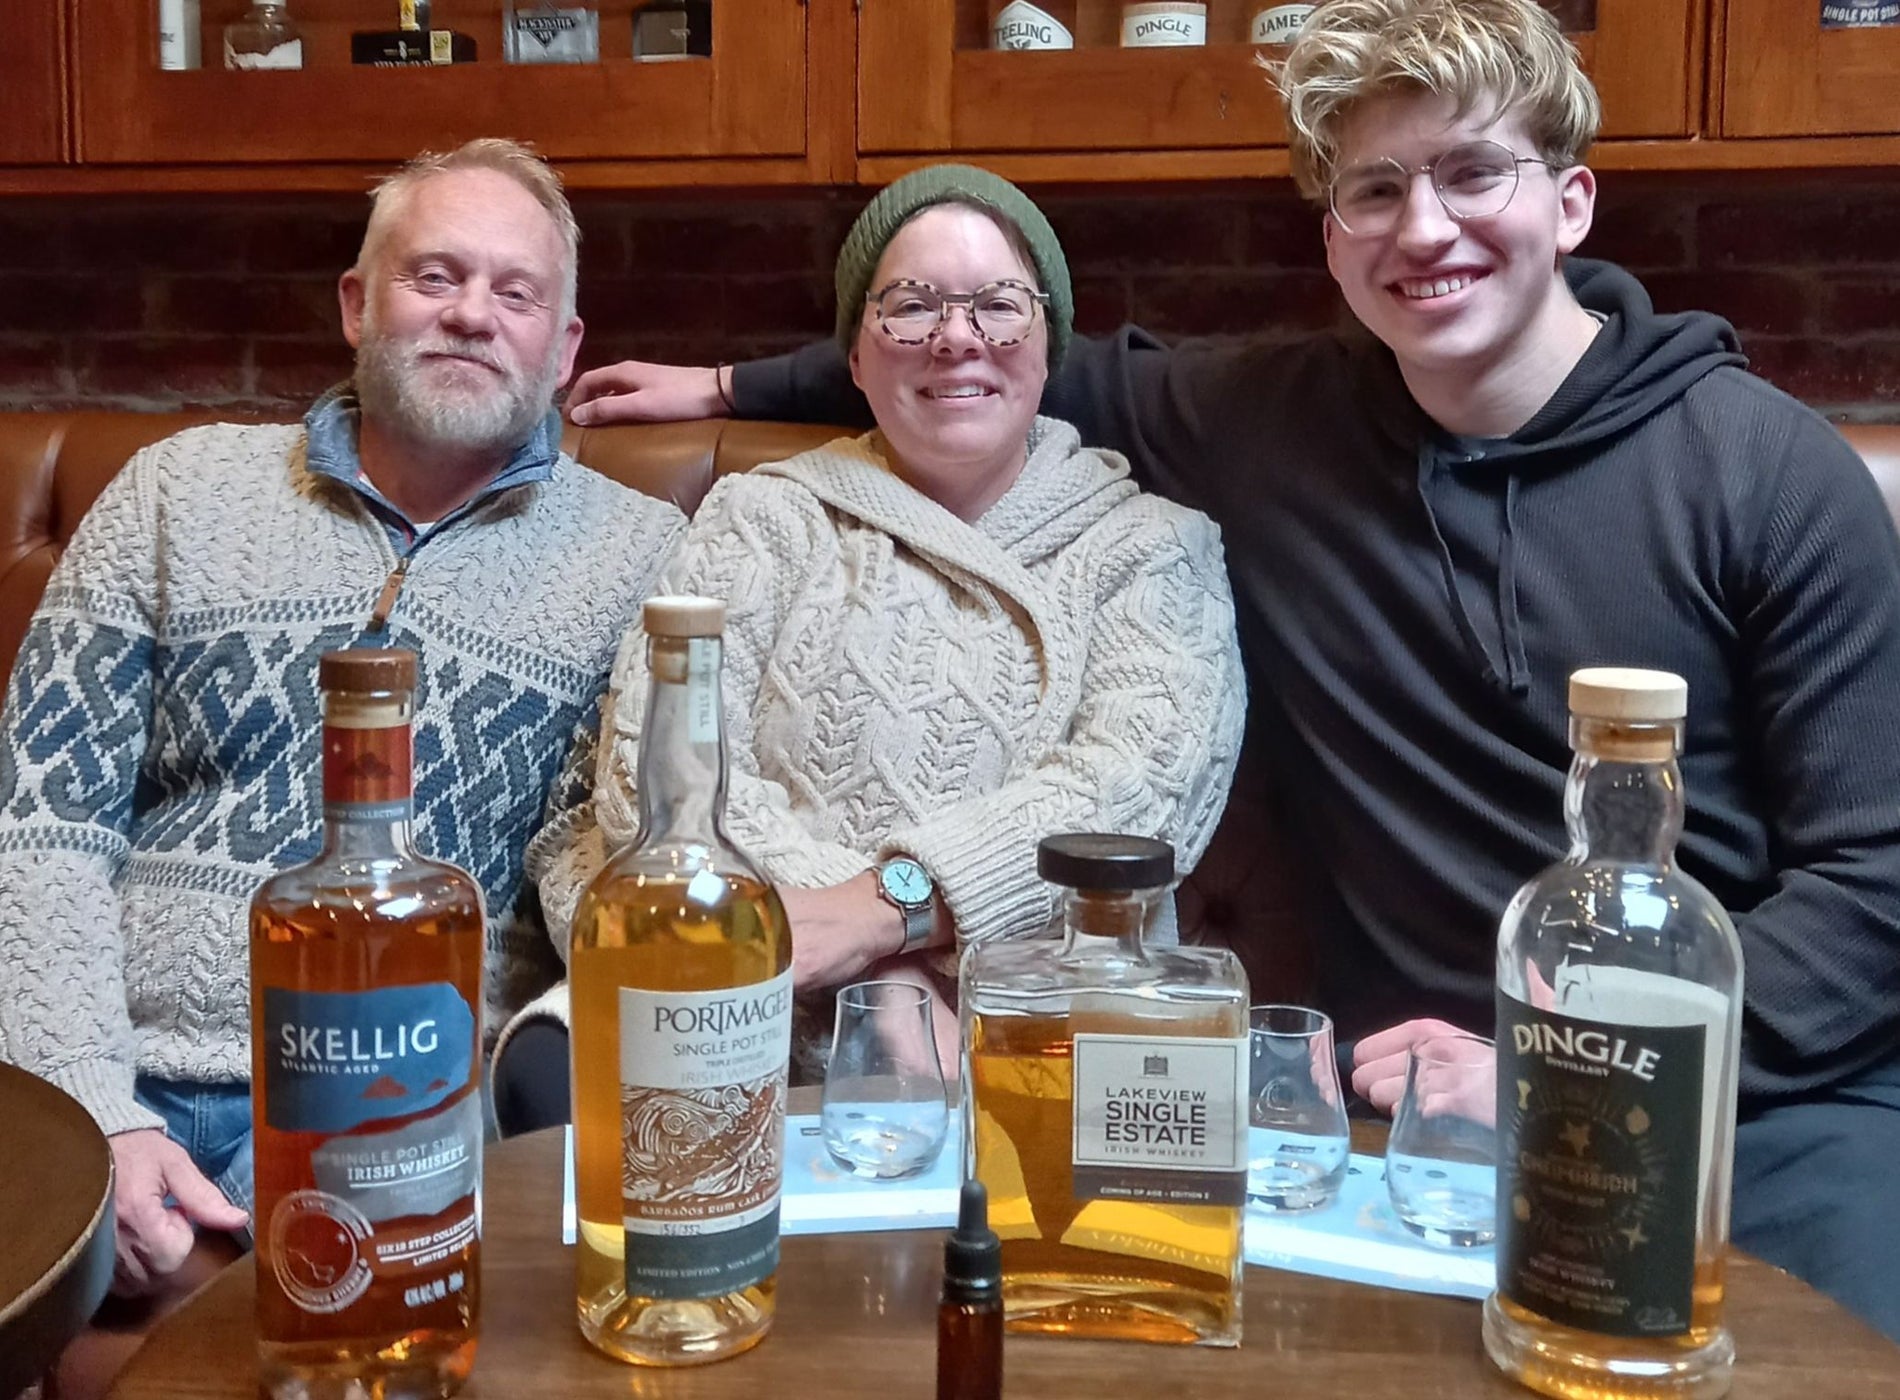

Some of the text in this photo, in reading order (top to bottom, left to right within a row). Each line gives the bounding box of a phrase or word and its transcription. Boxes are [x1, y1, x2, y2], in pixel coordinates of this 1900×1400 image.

[1823, 4, 1859, 21] SINGLE
[1860, 7, 1880, 21] POT
[995, 22, 1052, 45] TEELING
[1135, 19, 1192, 38] DINGLE
[280, 1019, 438, 1061] SKELLIG
[673, 1040, 727, 1057] SINGLE
[732, 1033, 758, 1051] POT
[1512, 1023, 1662, 1083] DINGLE
[281, 1058, 380, 1075] ATLANTIC AGED
[1105, 1086, 1207, 1102] LAKEVIEW
[1105, 1100, 1207, 1125] SINGLE
[1105, 1122, 1206, 1146] ESTATE
[329, 1149, 389, 1167] SINGLE
[396, 1144, 427, 1160] POT
[1104, 1145, 1206, 1158] IRISH WHISKEY
[347, 1144, 466, 1181] IRISH WHISKEY
[1170, 1190, 1203, 1199] EDITION
[640, 1204, 704, 1217] BARBADOS
[707, 1201, 736, 1214] RUM
[408, 1235, 432, 1250] STEP
[412, 1247, 449, 1267] LIMITED
[680, 1264, 721, 1277] EDITION
